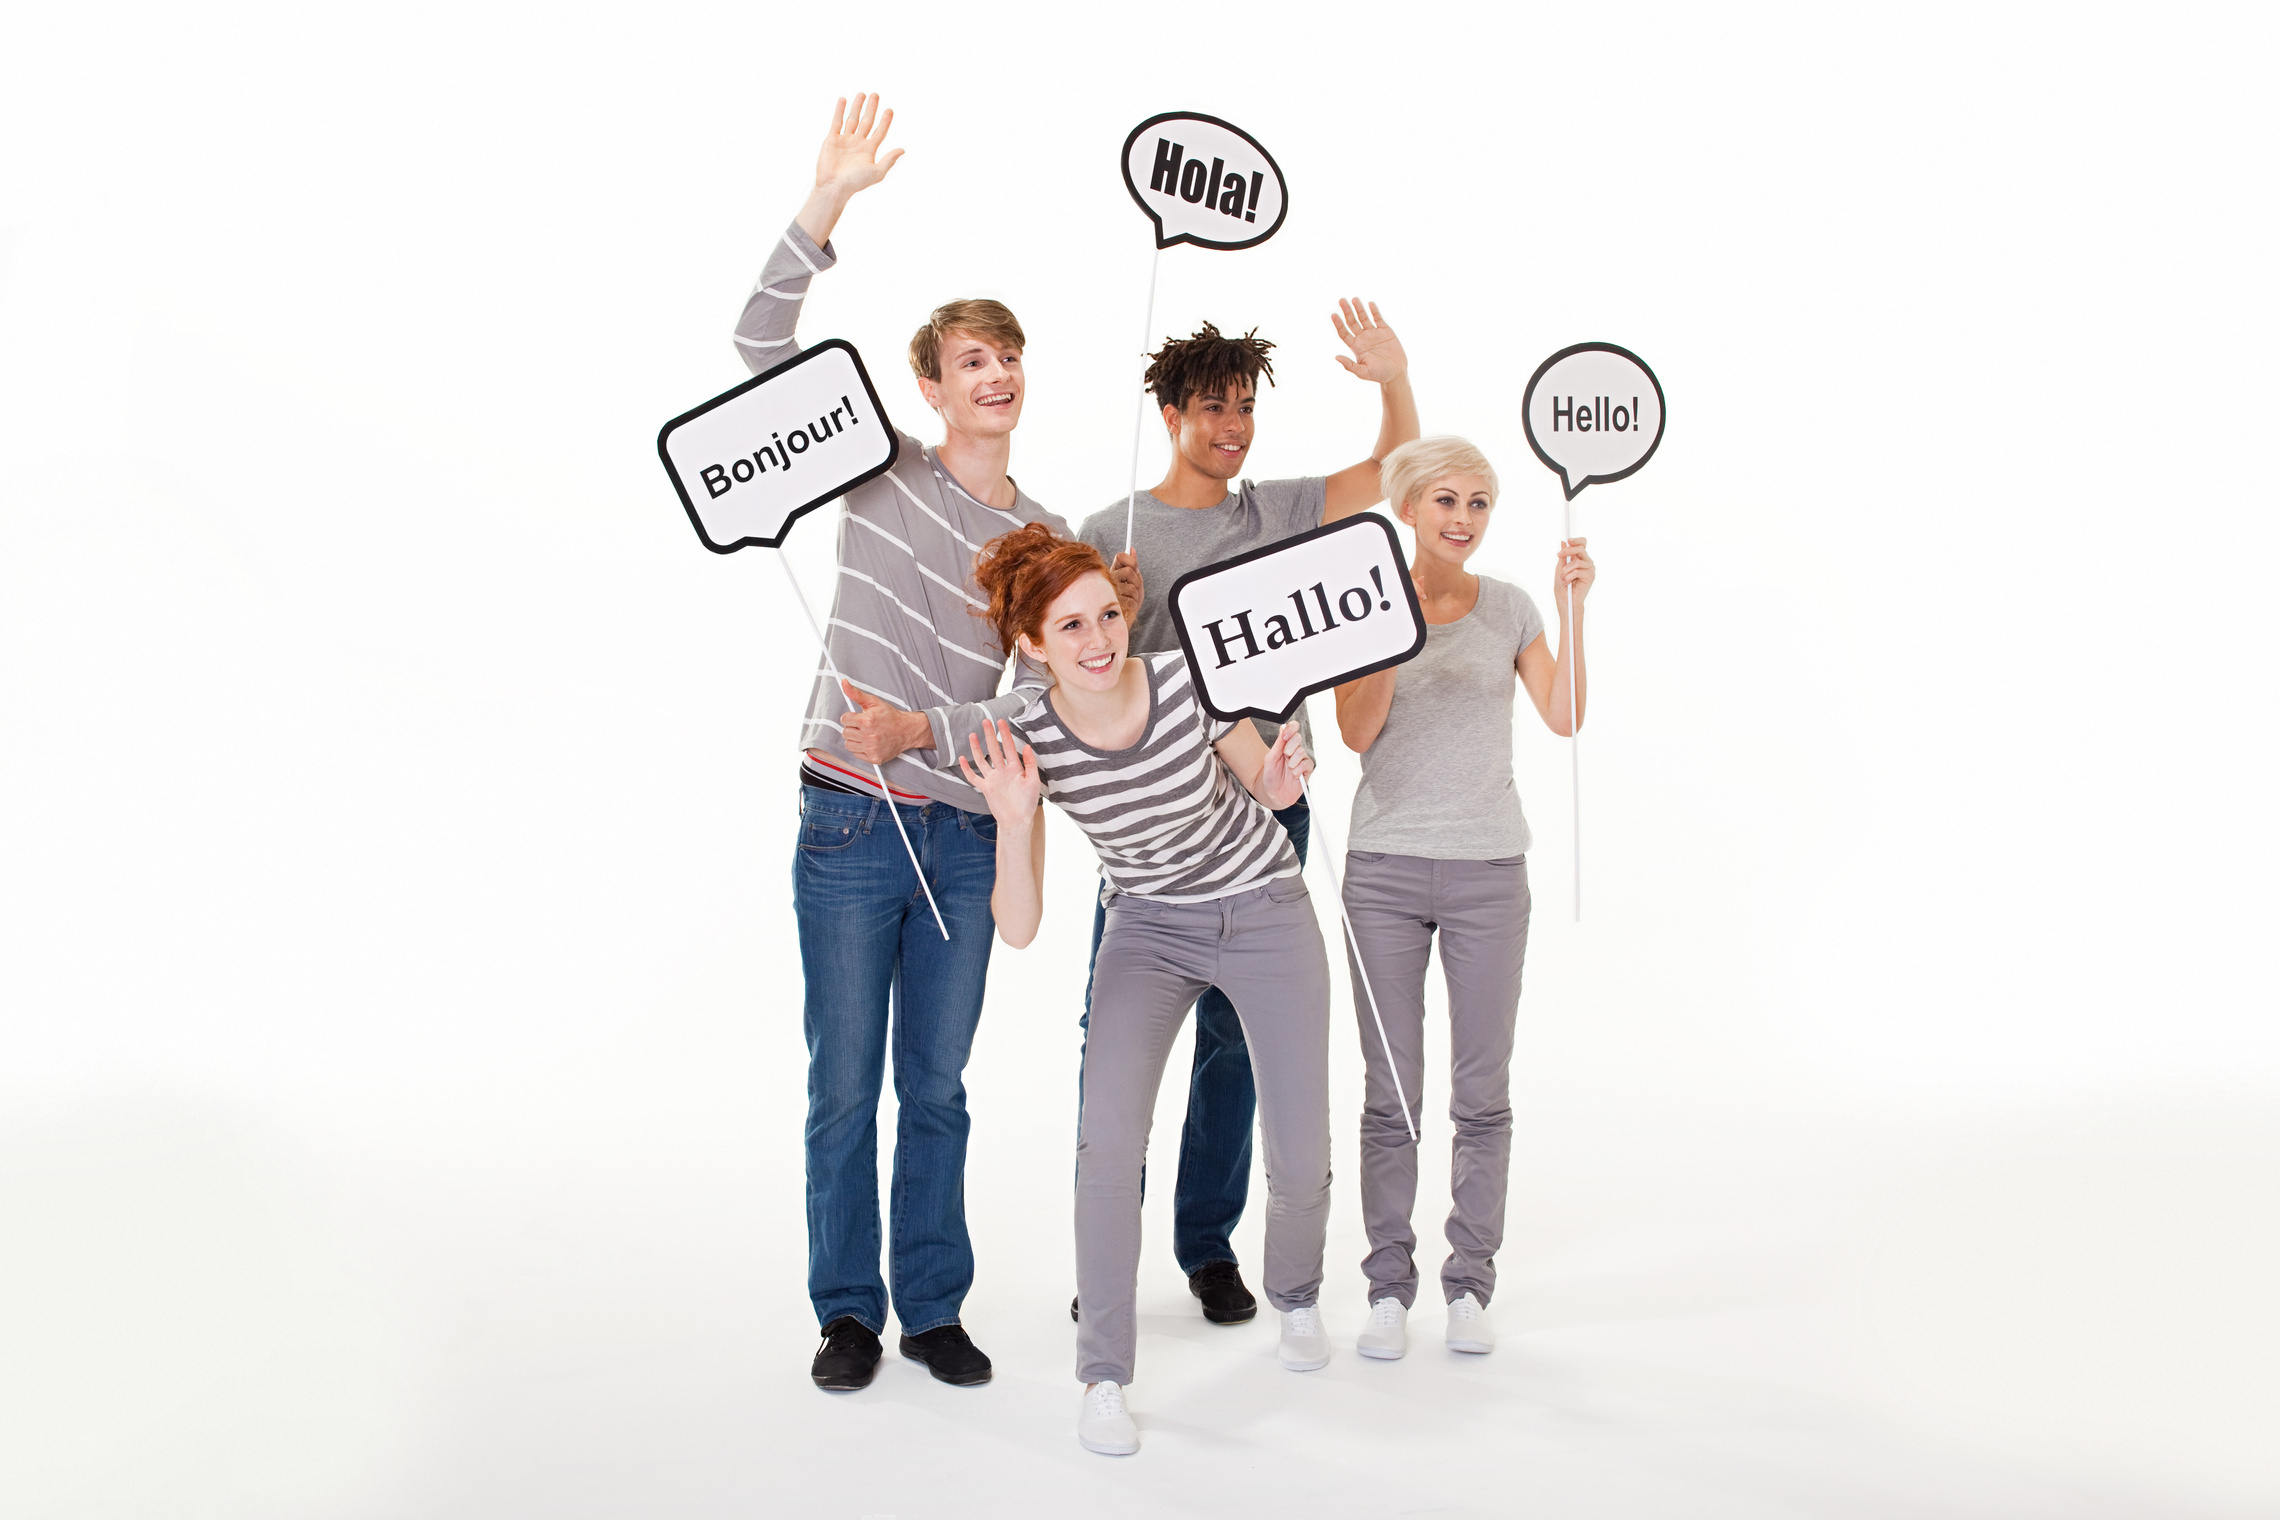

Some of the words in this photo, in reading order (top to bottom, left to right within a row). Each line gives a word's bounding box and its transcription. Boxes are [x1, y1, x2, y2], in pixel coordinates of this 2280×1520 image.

[1149, 137, 1264, 224] Hola!
[699, 395, 859, 500] Bonjour!
[1553, 396, 1639, 433] Hello!
[1201, 565, 1391, 670] Hallo!
